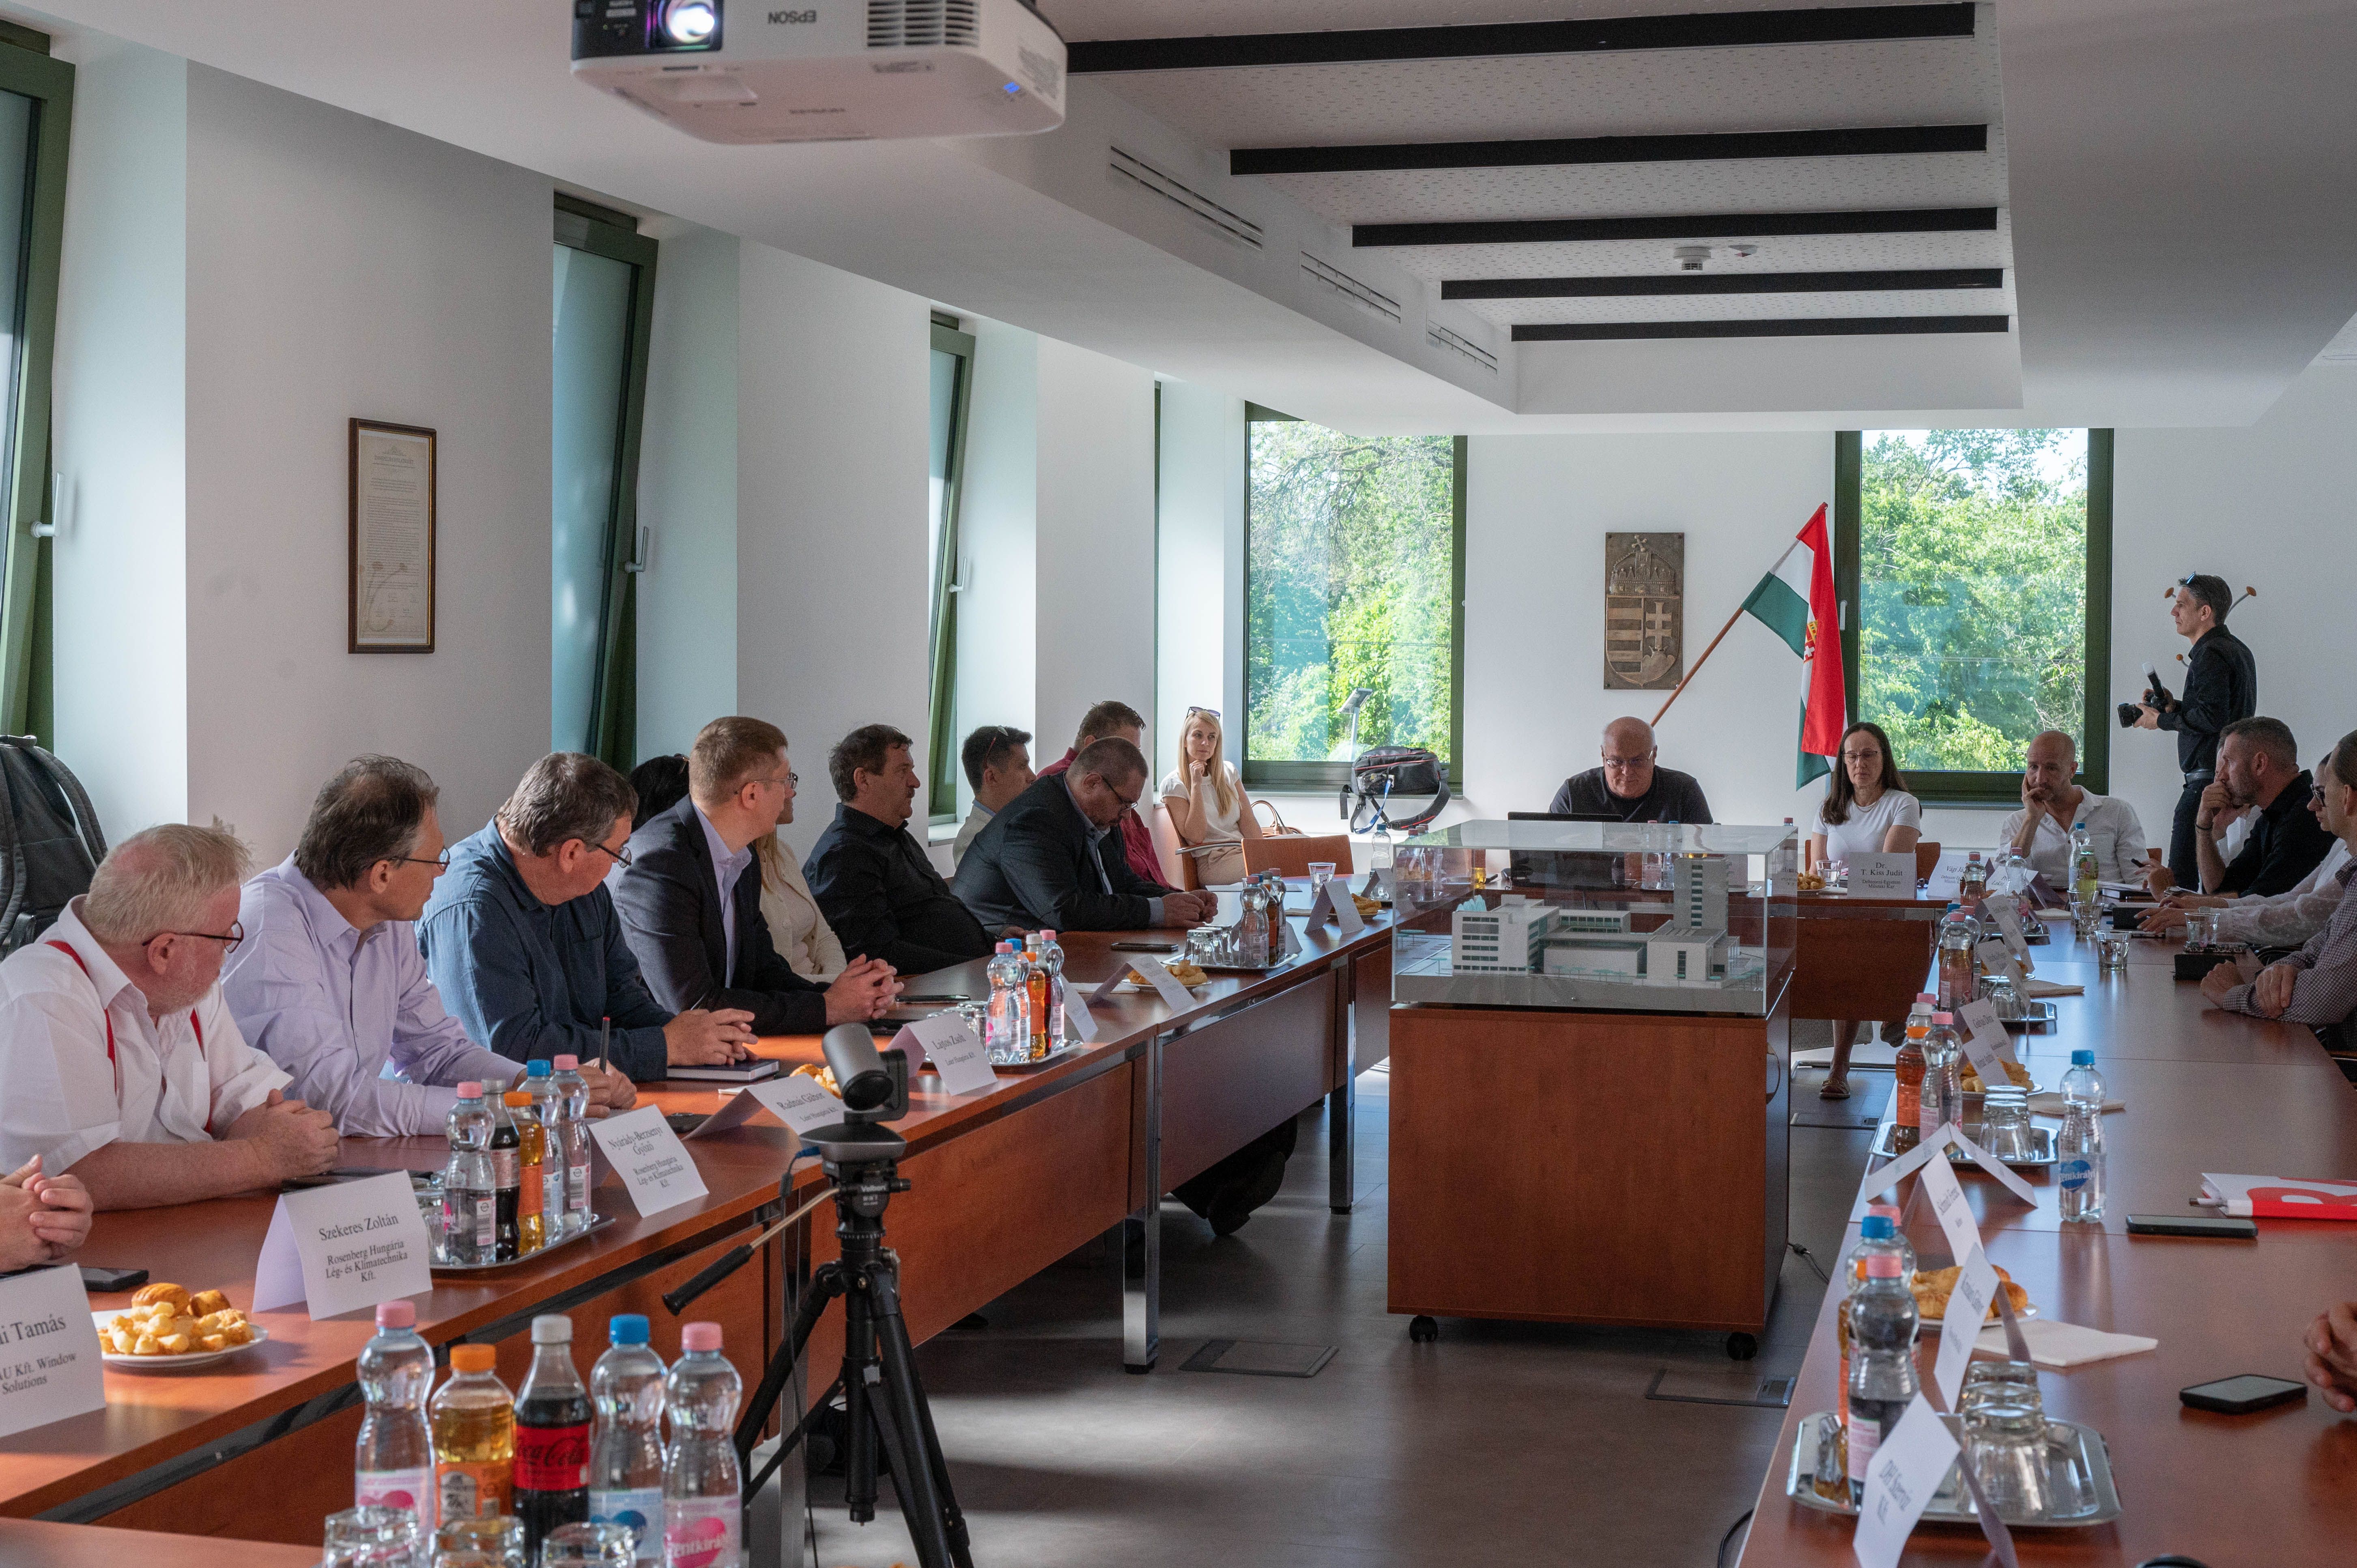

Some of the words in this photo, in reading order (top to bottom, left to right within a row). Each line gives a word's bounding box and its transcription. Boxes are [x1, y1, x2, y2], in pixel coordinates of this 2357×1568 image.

[768, 10, 816, 23] EPSON
[949, 1033, 966, 1045] Zsolt
[318, 1225, 363, 1241] Szekeres
[363, 1214, 399, 1231] Zoltán
[326, 1267, 343, 1278] Lég-
[345, 1264, 353, 1274] és
[354, 1251, 408, 1272] Klimatechnika
[327, 1250, 368, 1266] Rosenberg
[369, 1240, 404, 1256] Hungária
[361, 1270, 376, 1282] Kft.
[10, 1313, 66, 1340] Tamás
[15, 1362, 34, 1376] Kft.
[36, 1353, 76, 1369] Window
[2, 1375, 47, 1394] Solutions
